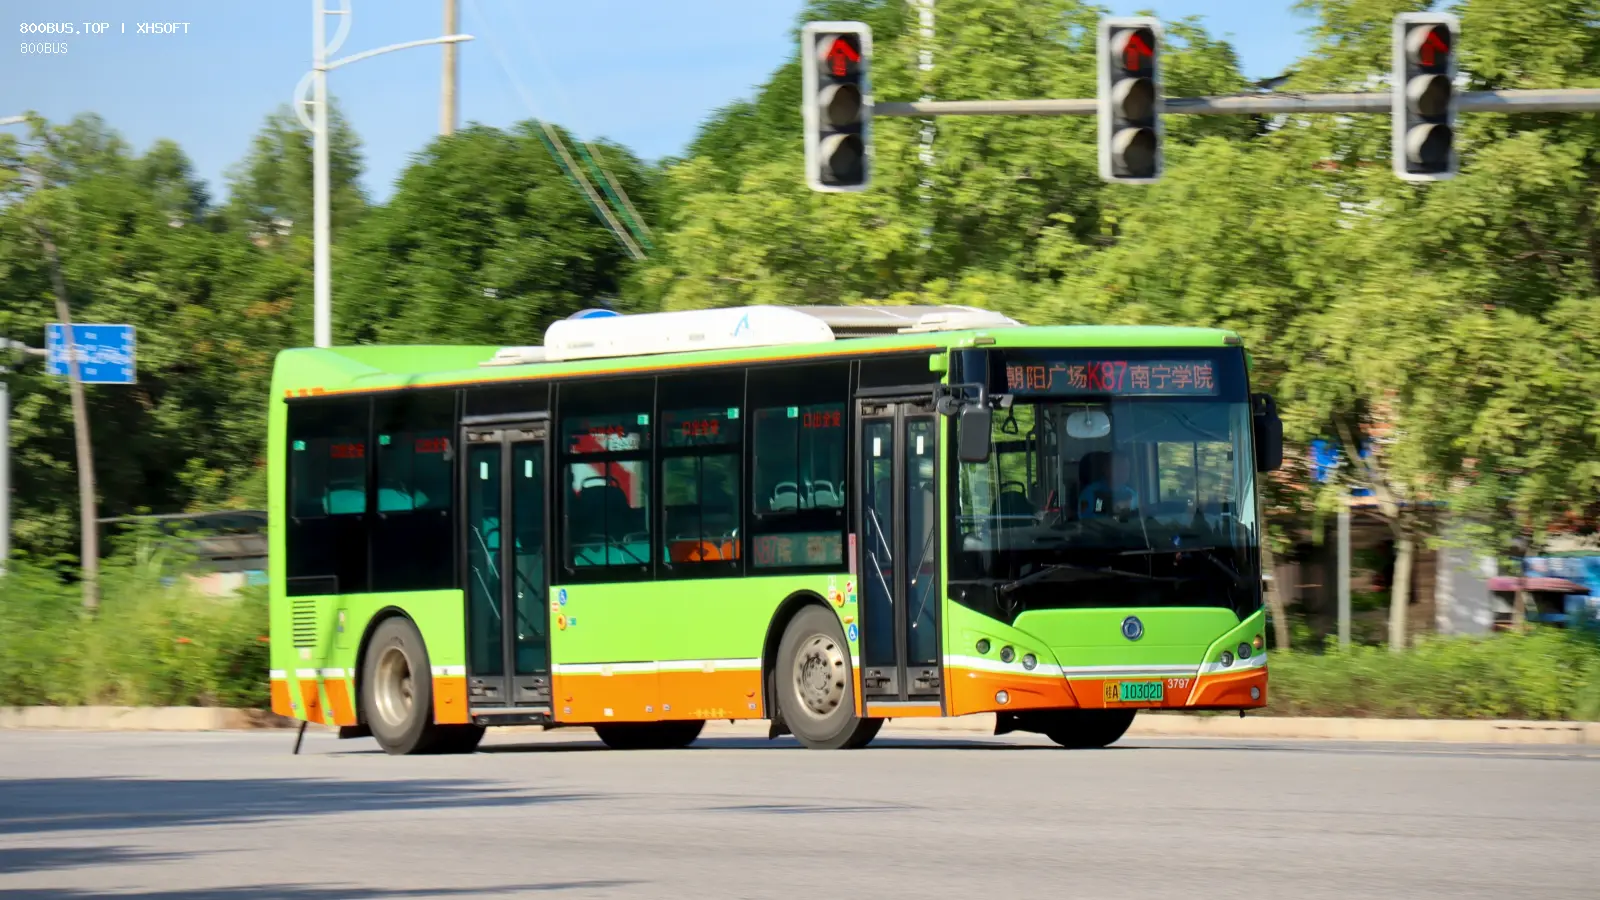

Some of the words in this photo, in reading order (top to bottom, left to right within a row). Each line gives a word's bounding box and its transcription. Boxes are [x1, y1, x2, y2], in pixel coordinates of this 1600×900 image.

[1088, 361, 1128, 391] K87
[1129, 364, 1213, 390] 南宁学院
[1167, 678, 1189, 689] 3797
[1124, 684, 1163, 699] 10302D
